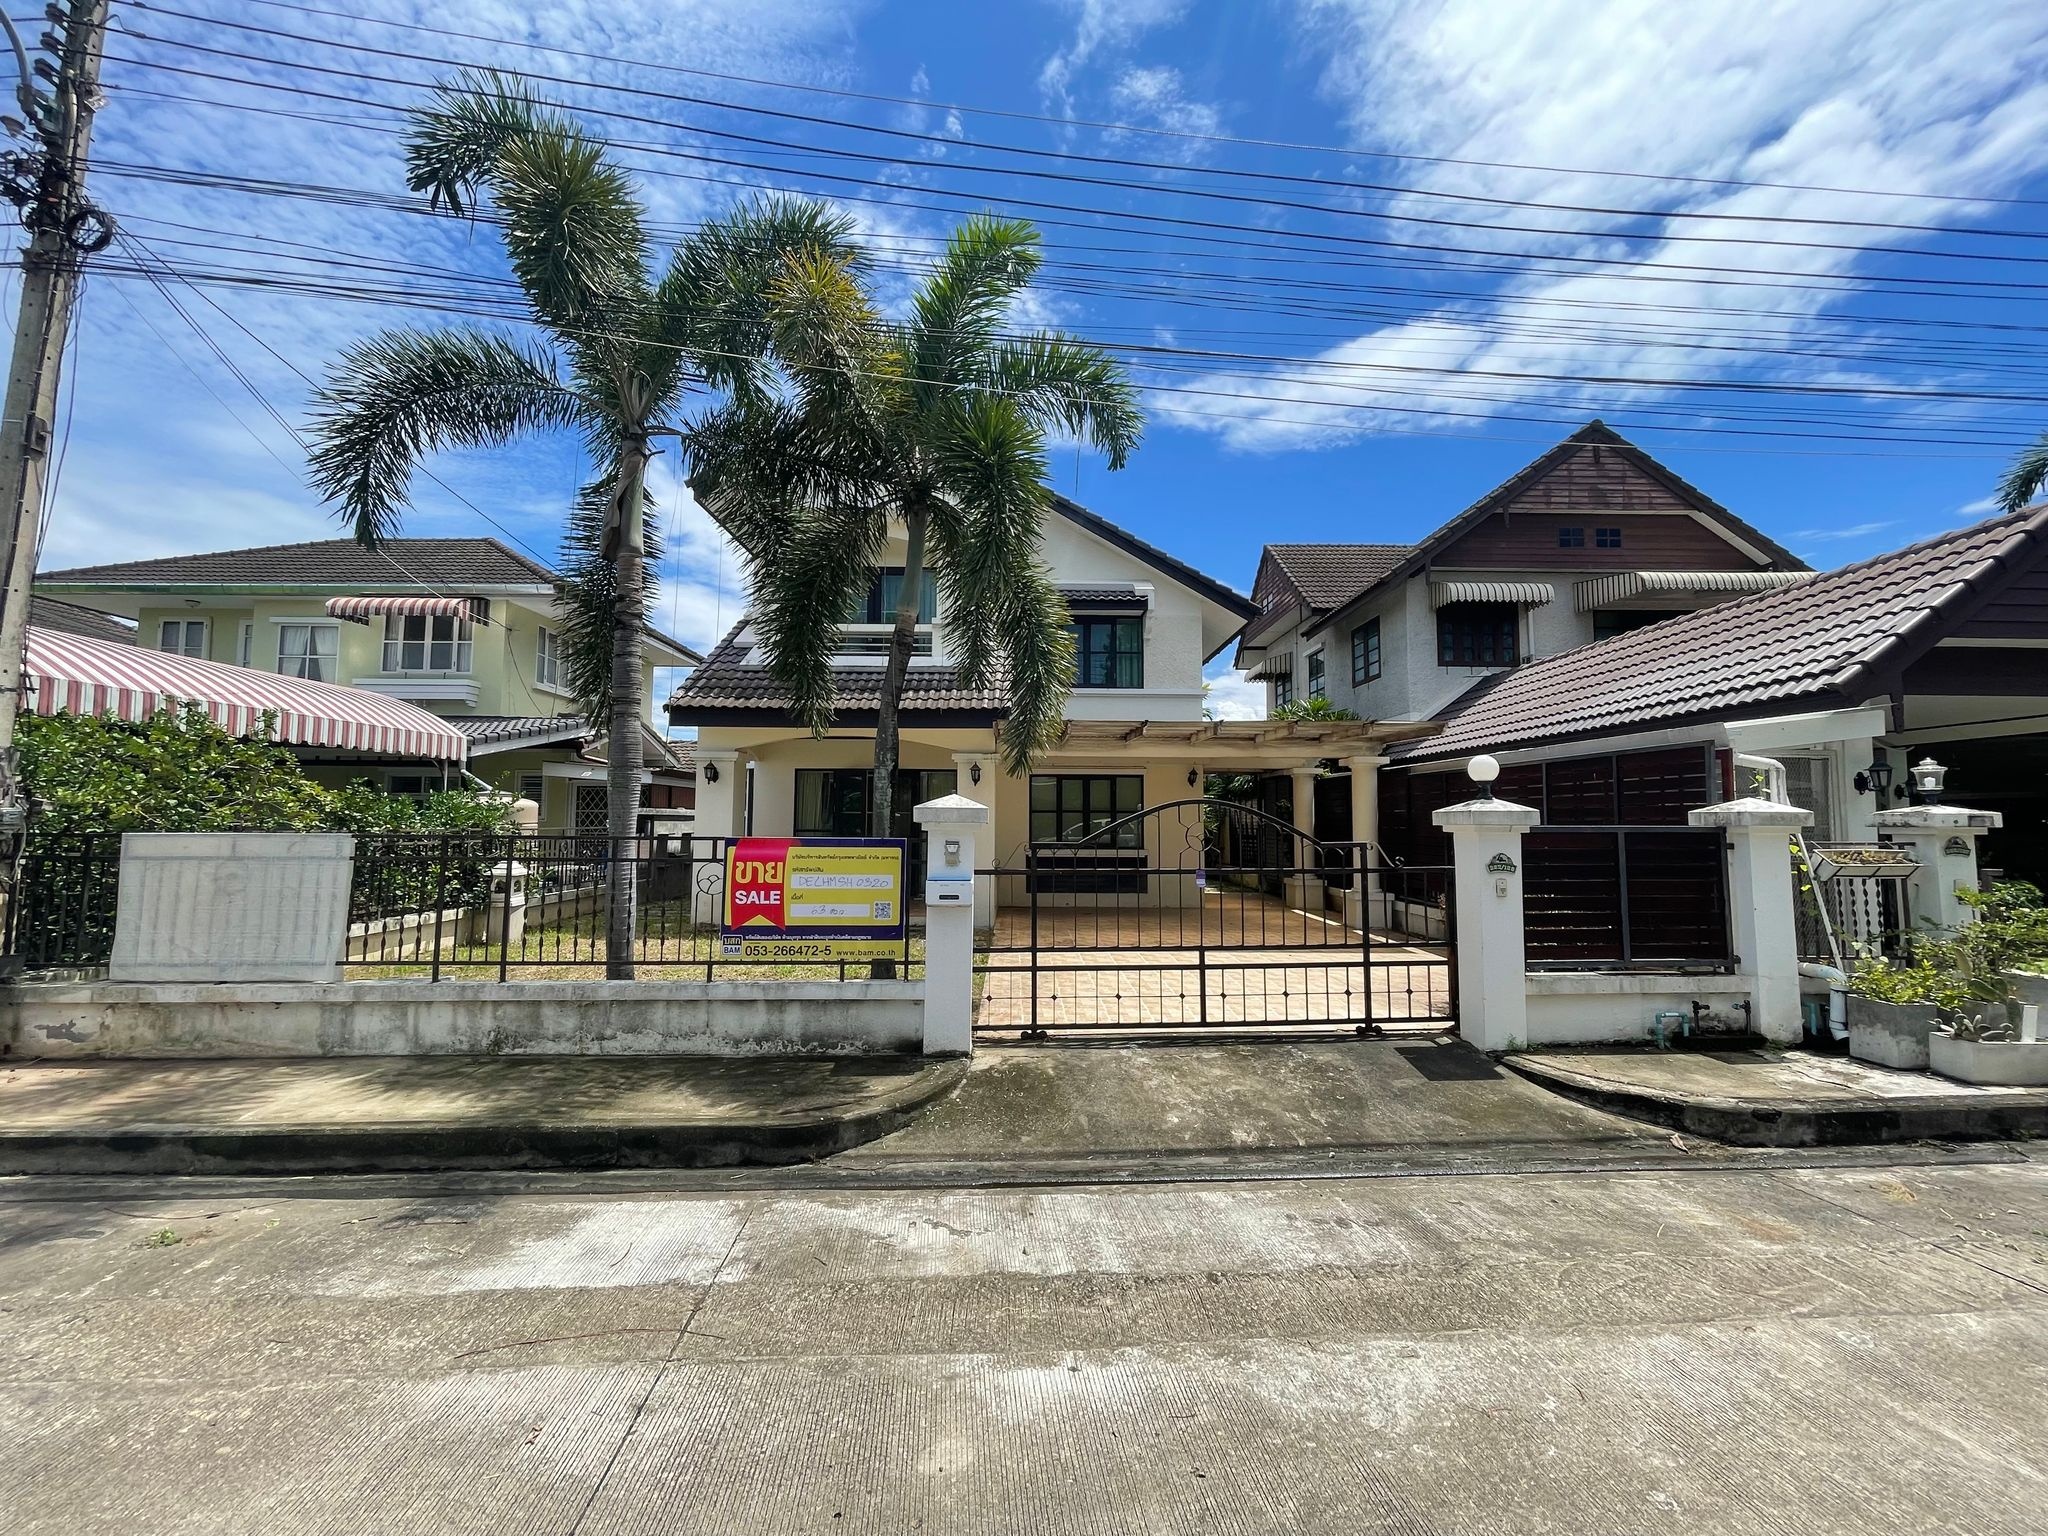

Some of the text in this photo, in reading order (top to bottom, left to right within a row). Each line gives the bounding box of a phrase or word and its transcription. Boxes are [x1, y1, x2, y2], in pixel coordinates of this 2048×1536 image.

[735, 861, 784, 884] ขาย
[735, 890, 781, 904] SALE
[724, 946, 741, 954] BAM
[745, 945, 831, 956] 053-266472-5
